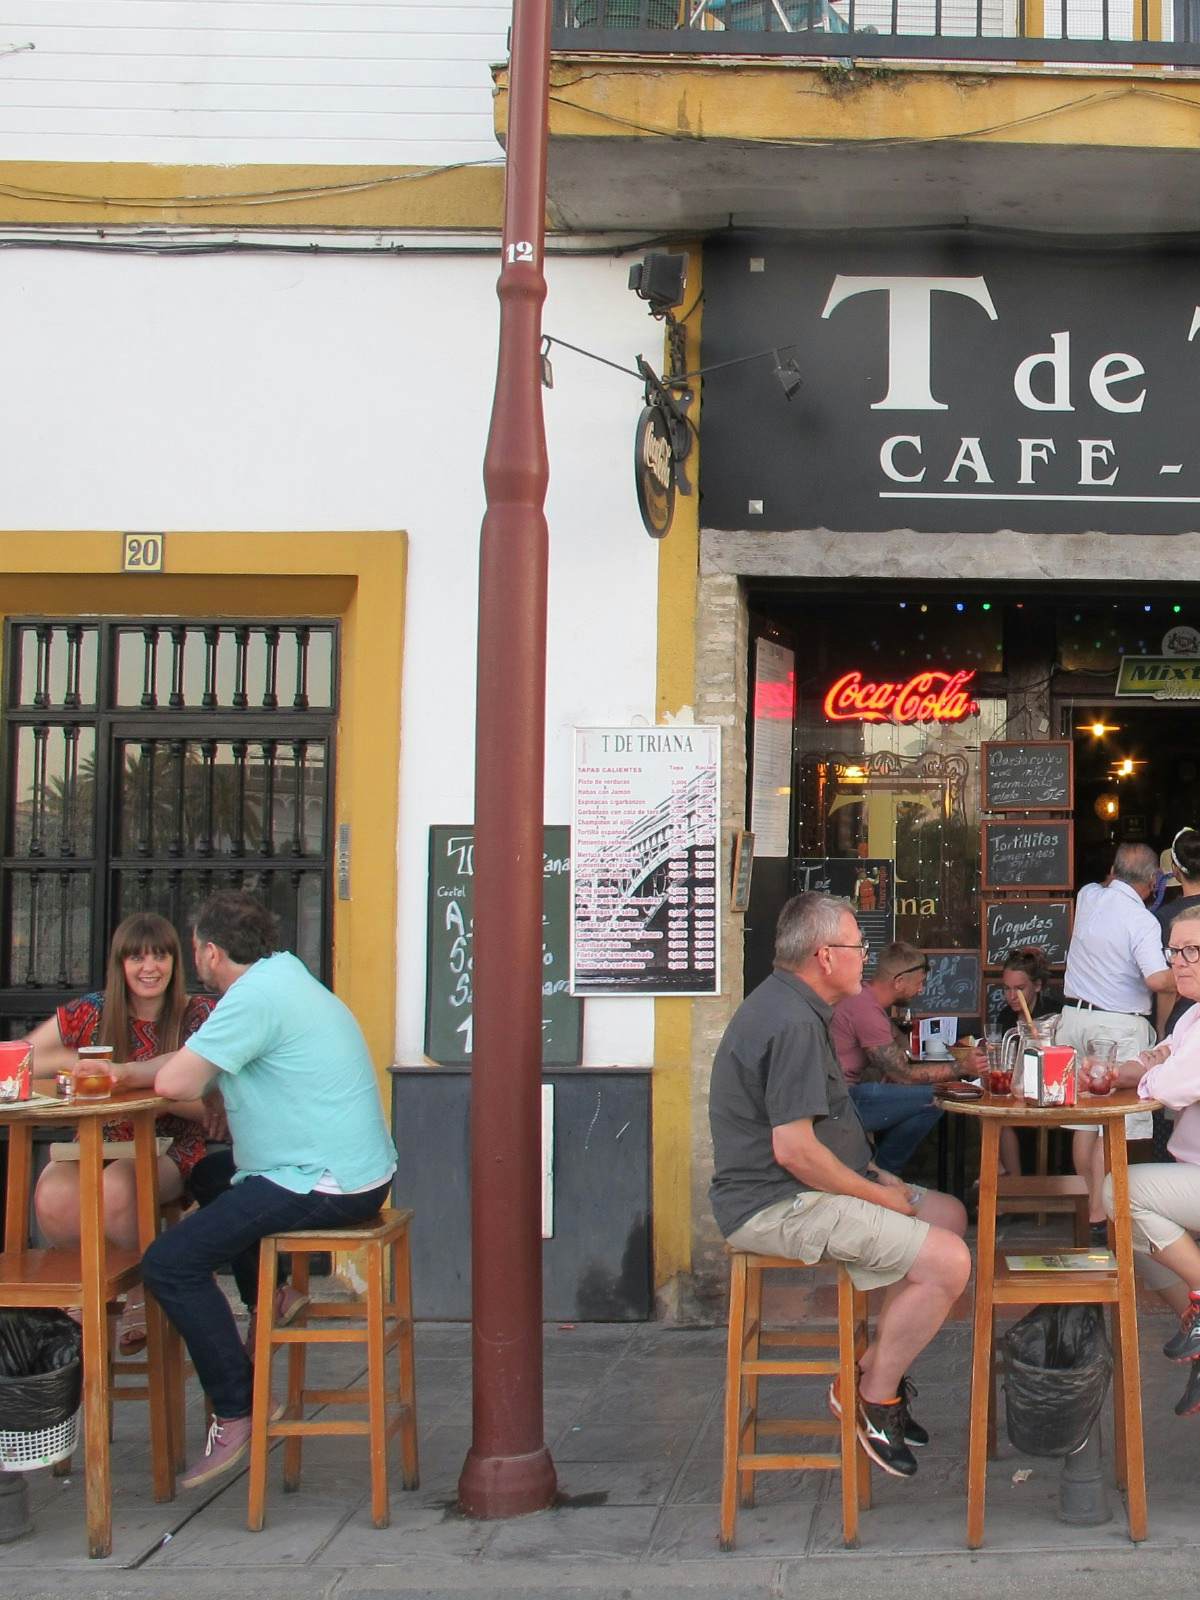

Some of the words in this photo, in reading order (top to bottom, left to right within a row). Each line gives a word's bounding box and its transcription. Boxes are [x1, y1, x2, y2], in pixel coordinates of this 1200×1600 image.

[506, 241, 533, 263] 12
[820, 274, 999, 410] T
[1013, 330, 1147, 414] de
[879, 435, 1120, 486] CAFE
[127, 538, 160, 567] 20
[824, 670, 975, 722] Coca-Cola
[602, 735, 611, 752] T
[615, 735, 633, 752] DE
[638, 735, 693, 752] TRIANA
[992, 914, 1054, 938] Croquetas
